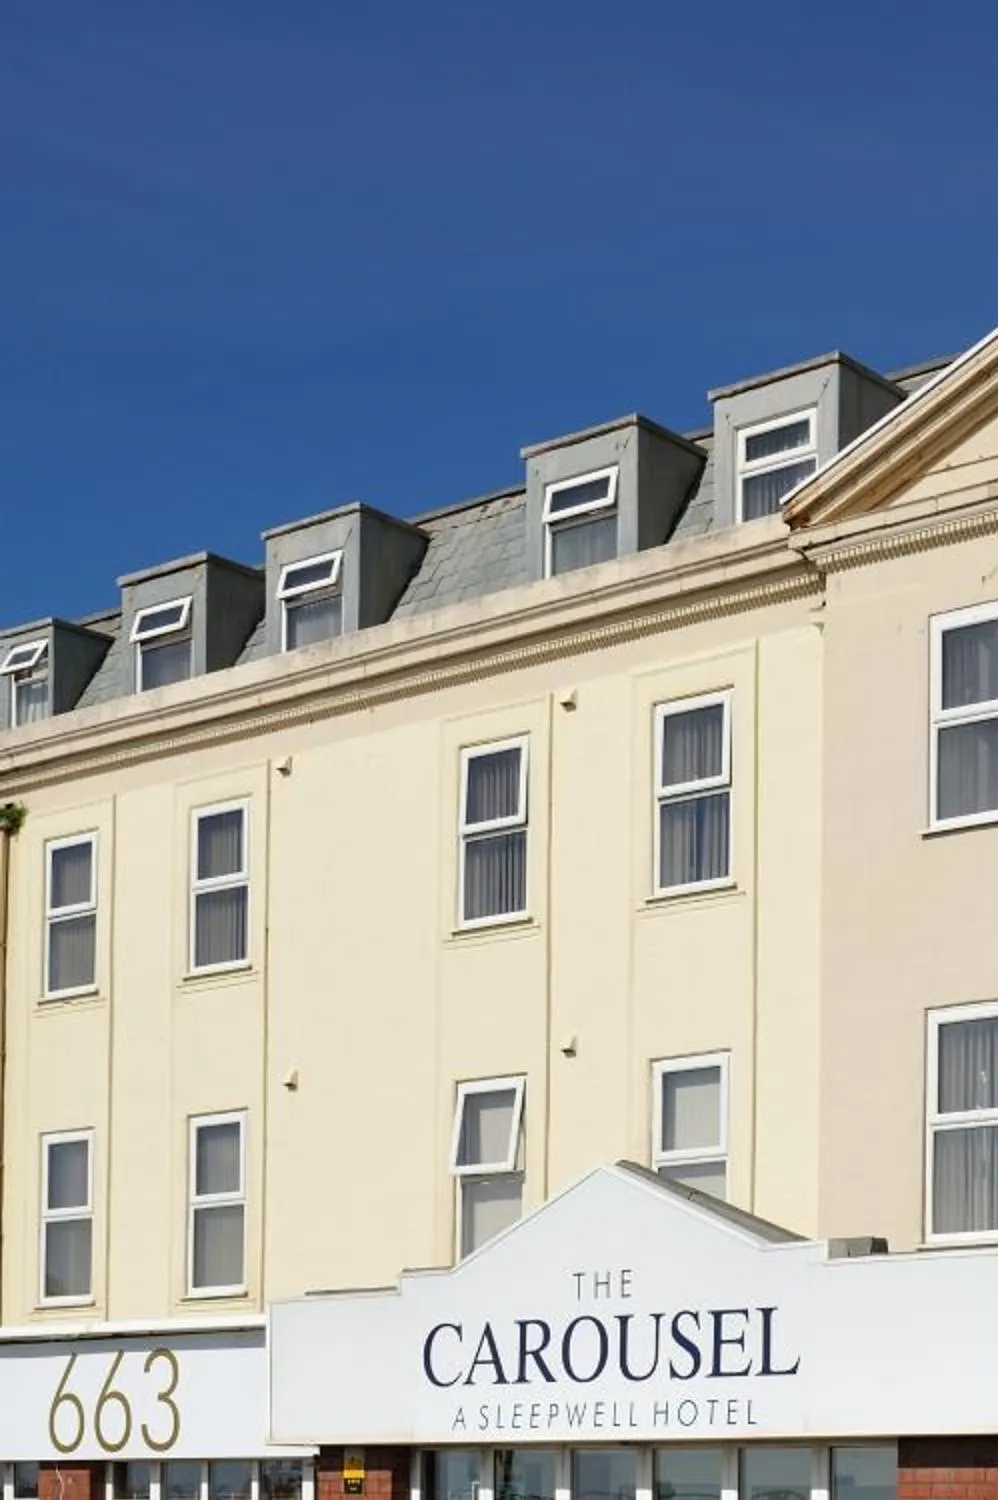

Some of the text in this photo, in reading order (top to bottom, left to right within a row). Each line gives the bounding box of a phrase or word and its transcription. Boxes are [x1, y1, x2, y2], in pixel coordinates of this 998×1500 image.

[572, 1269, 633, 1300] THE
[423, 1306, 801, 1387] CAROUSEL
[49, 1347, 181, 1454] 663
[452, 1399, 758, 1431] A SLEEPWELL HOTEL
